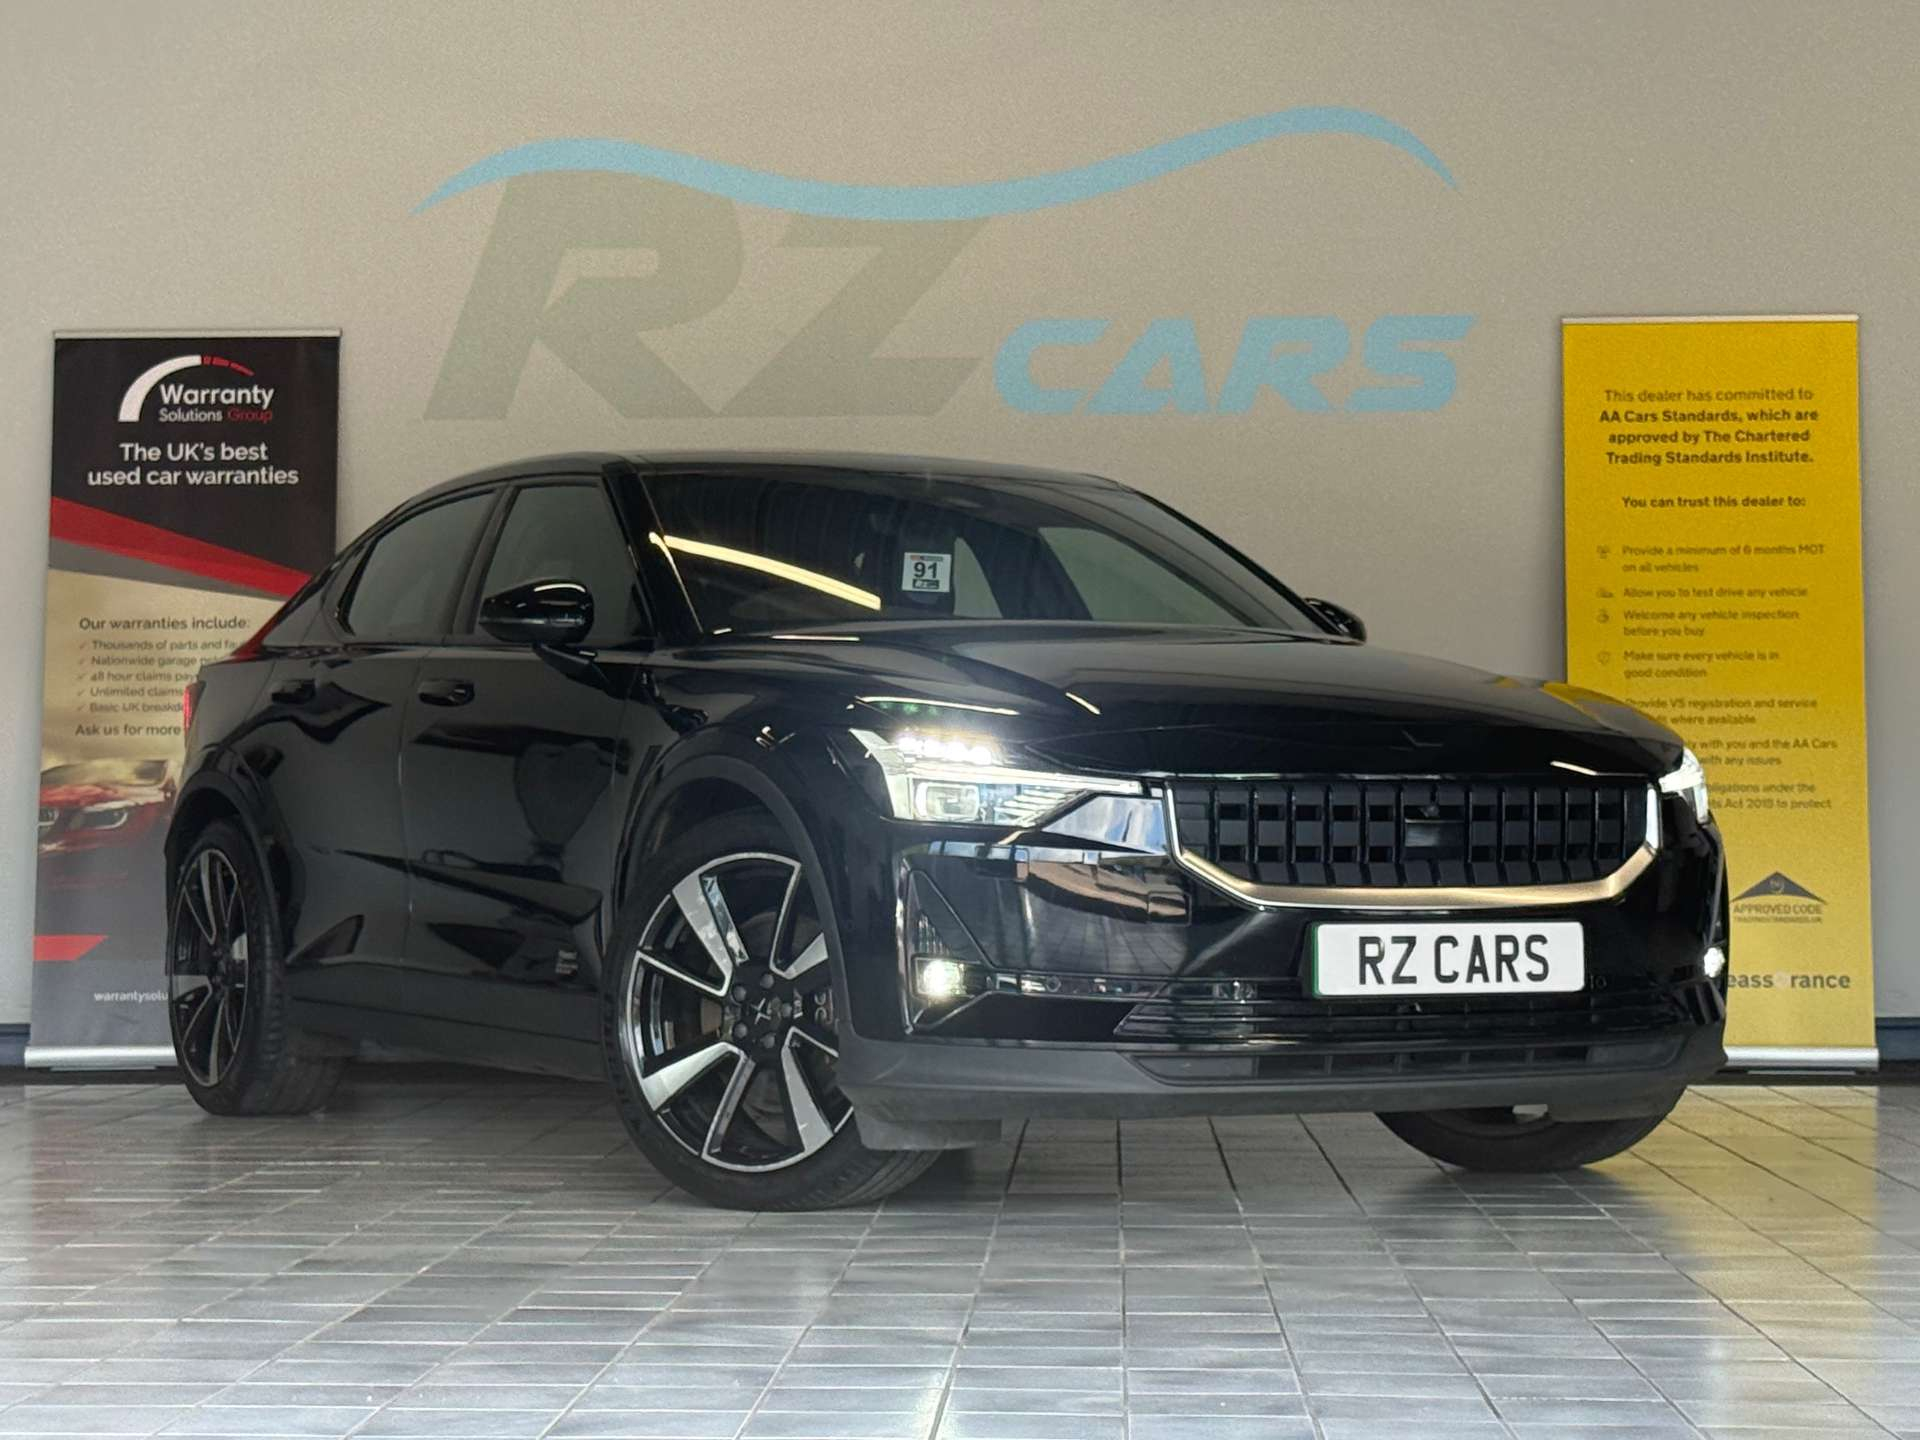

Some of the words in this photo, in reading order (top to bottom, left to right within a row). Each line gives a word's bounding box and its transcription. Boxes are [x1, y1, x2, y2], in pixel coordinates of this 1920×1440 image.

[424, 177, 990, 420] RZ
[994, 314, 1476, 415] CARS
[159, 383, 274, 408] Warranty
[1605, 389, 1634, 401] This
[1638, 389, 1681, 401] dealer
[1686, 389, 1712, 401] has
[1716, 388, 1794, 401] committed
[1798, 388, 1813, 400] to
[159, 408, 223, 423] Solutions
[227, 409, 272, 424] Group
[1600, 410, 1620, 422] AA
[1624, 410, 1657, 422] Cars
[1662, 409, 1742, 423] Standards,
[1746, 409, 1790, 421] which
[1795, 410, 1818, 421] are
[1609, 431, 1678, 445] approved
[1683, 431, 1699, 445] by
[1704, 430, 1731, 443] The
[1735, 430, 1810, 442] Chartered
[119, 443, 161, 461] The
[167, 442, 215, 461] UK's
[220, 442, 268, 460] best
[1606, 452, 1662, 466] Trading
[1666, 451, 1742, 464] Standards
[1746, 451, 1813, 464] Institute.
[87, 467, 141, 486] used
[146, 470, 182, 485] car
[185, 466, 299, 485] warranties
[1622, 497, 1646, 508] You
[1650, 499, 1674, 508] can
[1678, 497, 1710, 507] trust
[1713, 496, 1738, 507] this
[1742, 496, 1784, 507] dealer
[1787, 496, 1806, 507] to:
[1622, 545, 1664, 556] Provide
[1676, 545, 1726, 555] minimum
[1729, 545, 1741, 555] of
[1754, 544, 1796, 555] months
[914, 562, 937, 578] 91
[1622, 563, 1637, 572] on
[1655, 562, 1699, 573] vehicles
[1624, 587, 1652, 597] Allow
[1655, 588, 1675, 600] you
[1678, 587, 1690, 597] to
[1692, 587, 1713, 597] test
[1715, 587, 1744, 597] drive
[1747, 588, 1767, 599] any
[1768, 586, 1808, 597] vehicle
[1624, 609, 1675, 620] Welcome
[1678, 611, 1697, 622] any
[1700, 609, 1739, 620] vehicle
[1741, 609, 1799, 622] inspection
[79, 617, 106, 630] Our
[110, 617, 187, 630] warranties
[1624, 626, 1659, 636] before
[1661, 627, 1681, 638] you
[1684, 626, 1705, 638] buy
[92, 640, 153, 650] Thousands
[156, 640, 167, 649] of
[170, 640, 198, 651] parts
[201, 640, 222, 649] and
[92, 656, 155, 666] Nationwide
[158, 658, 197, 667] garage
[1624, 651, 1653, 661] Make
[1657, 652, 1680, 661] sure
[1683, 652, 1714, 663] every
[1716, 650, 1754, 661] vehicle
[107, 671, 133, 681] hour
[136, 671, 172, 681] claims
[1624, 668, 1652, 680] good
[1655, 667, 1707, 678] condition
[90, 687, 145, 697] Unlimited
[90, 702, 119, 712] Basic
[122, 702, 140, 712] UK
[1754, 699, 1775, 708] and
[75, 724, 100, 736] Ask
[104, 726, 120, 735] us
[124, 724, 142, 735] for
[146, 725, 181, 735] more
[1749, 739, 1770, 749] and
[1812, 738, 1838, 749] Cars
[1733, 904, 1792, 914] APPROVED
[1793, 904, 1823, 914] CODE
[1359, 936, 1417, 985] RZ
[1434, 934, 1549, 983] CARS
[94, 990, 168, 1003] warrantysolu
